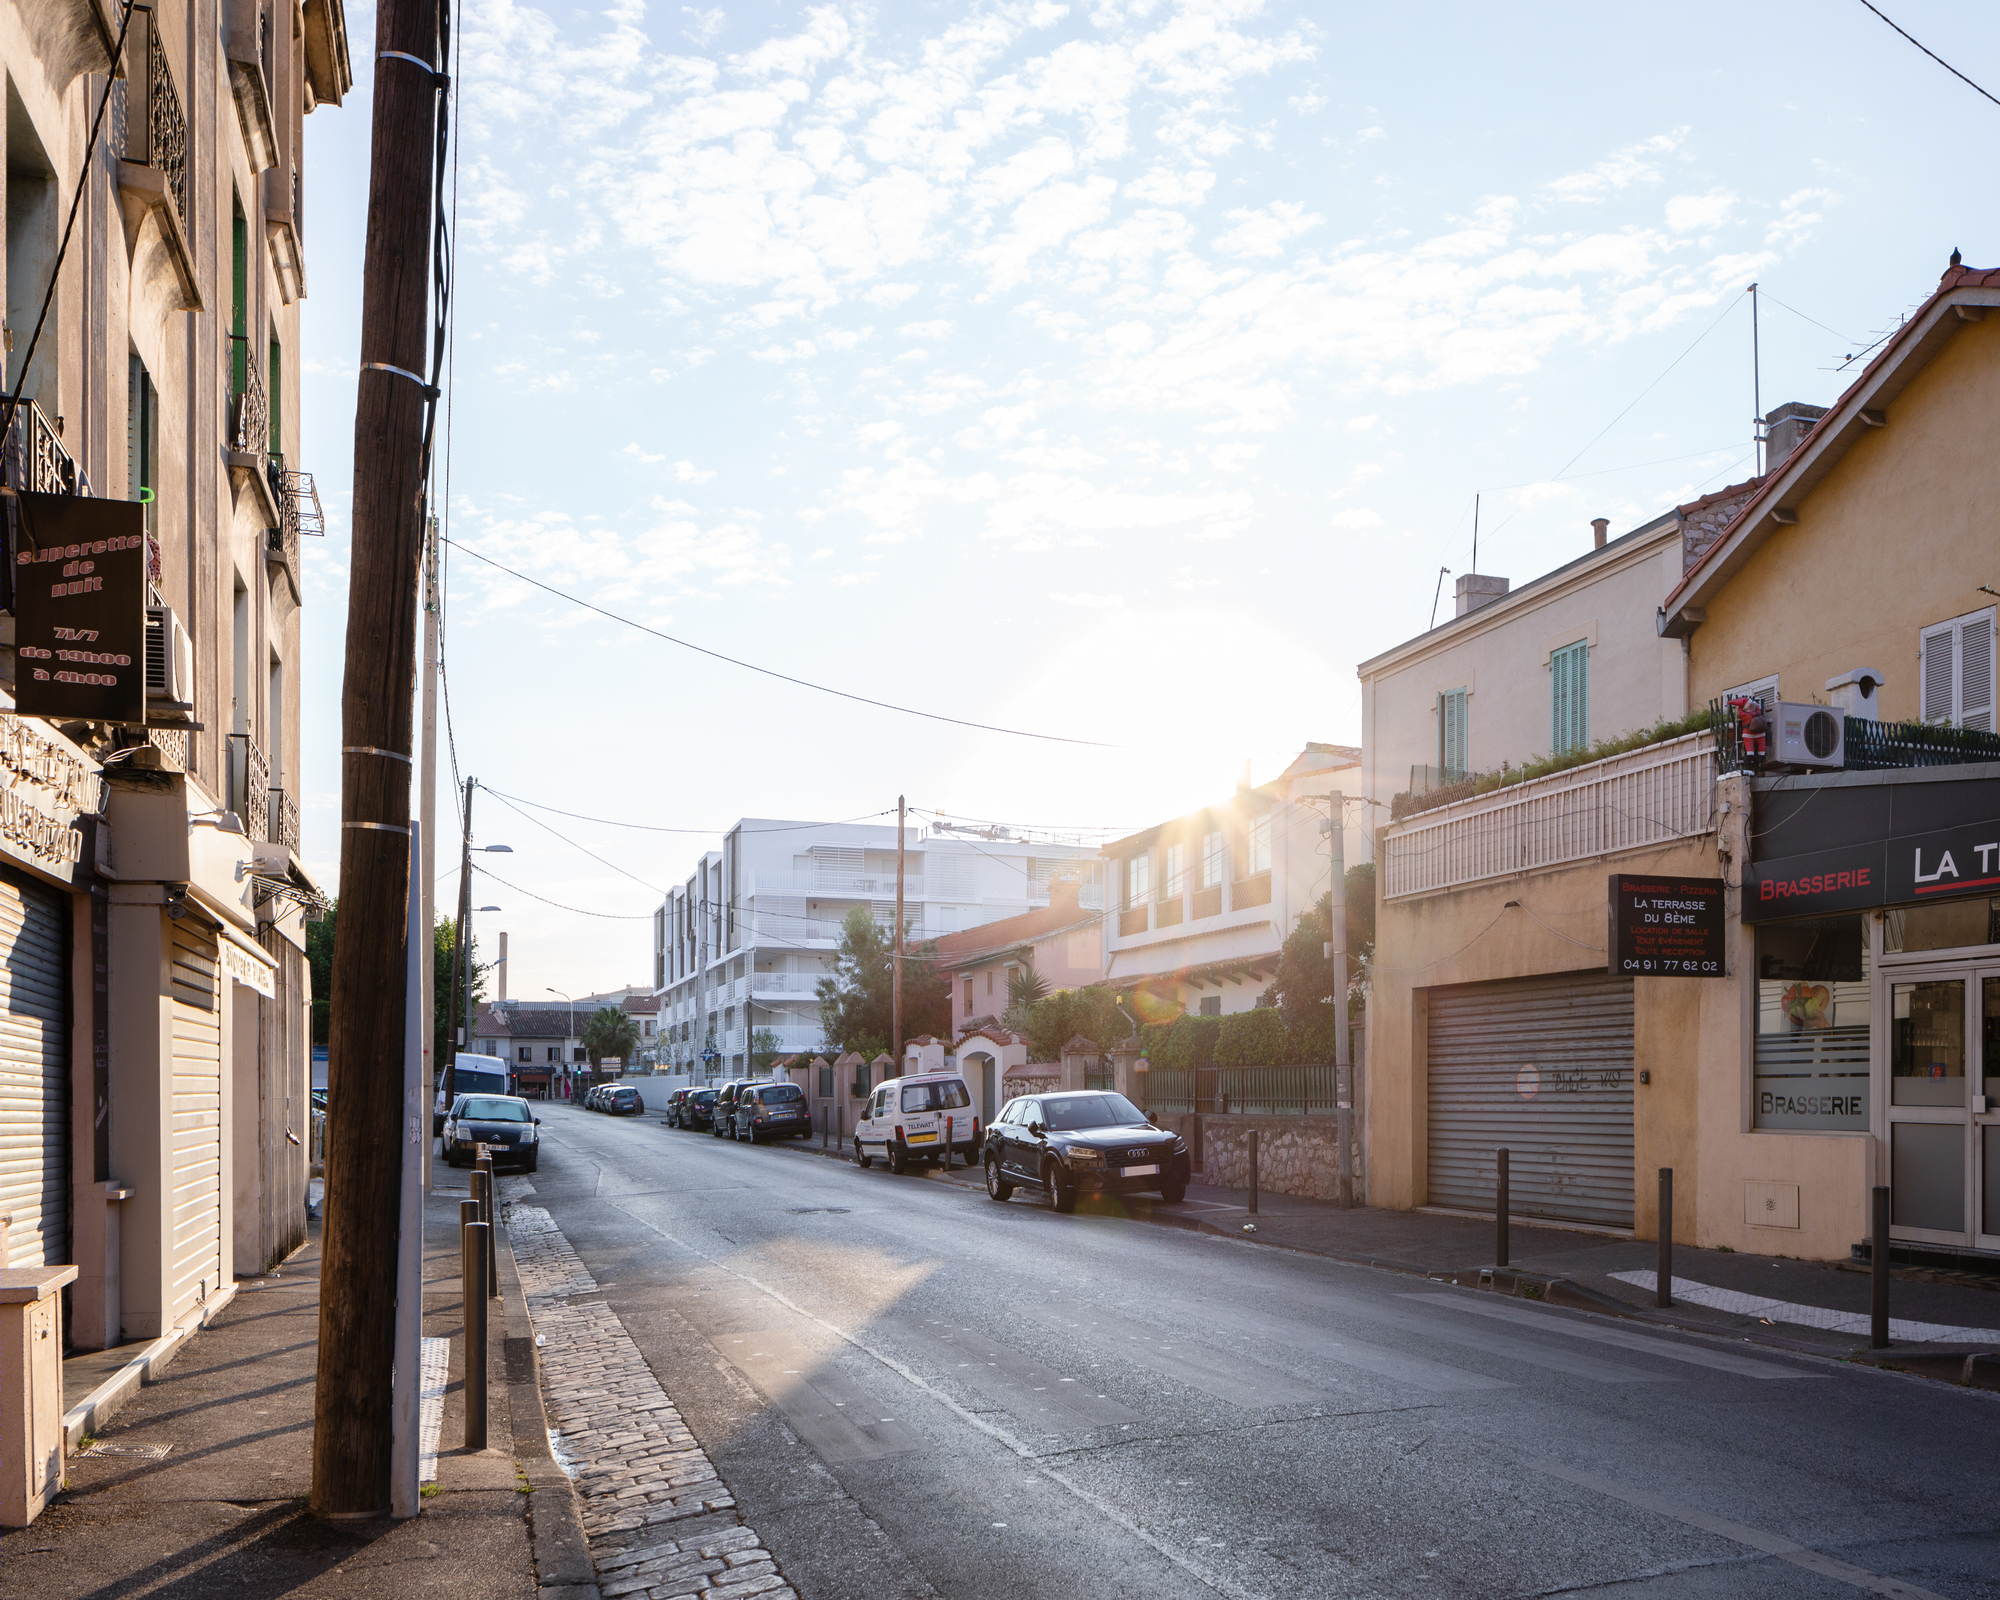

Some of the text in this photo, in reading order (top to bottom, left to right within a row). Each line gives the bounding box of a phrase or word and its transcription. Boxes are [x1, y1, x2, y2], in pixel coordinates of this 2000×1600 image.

[17, 535, 142, 565] superette
[63, 560, 95, 577] de
[51, 576, 103, 598] nuit
[20, 646, 131, 666] de 19h00
[32, 667, 117, 686] à 4h00
[1914, 842, 2000, 883] LA T
[1623, 883, 1671, 893] BRASSERIE
[1680, 885, 1718, 895] PIZZERIA
[1760, 867, 1871, 901] BRASSERIE
[1634, 896, 1706, 911] LA TERRASSE
[1644, 911, 1696, 924] DU 8ÈME
[1630, 925, 1709, 936] LOCATION DE SALLE
[1635, 935, 1704, 946] TOUT ÉVÉNEMENT
[1633, 946, 1706, 956] TOUTE RECEPTION
[1624, 959, 1718, 971] 04 91 77 62 02
[1761, 1091, 1863, 1116] BRASSERIE
[907, 1121, 935, 1130] TELEWATT
